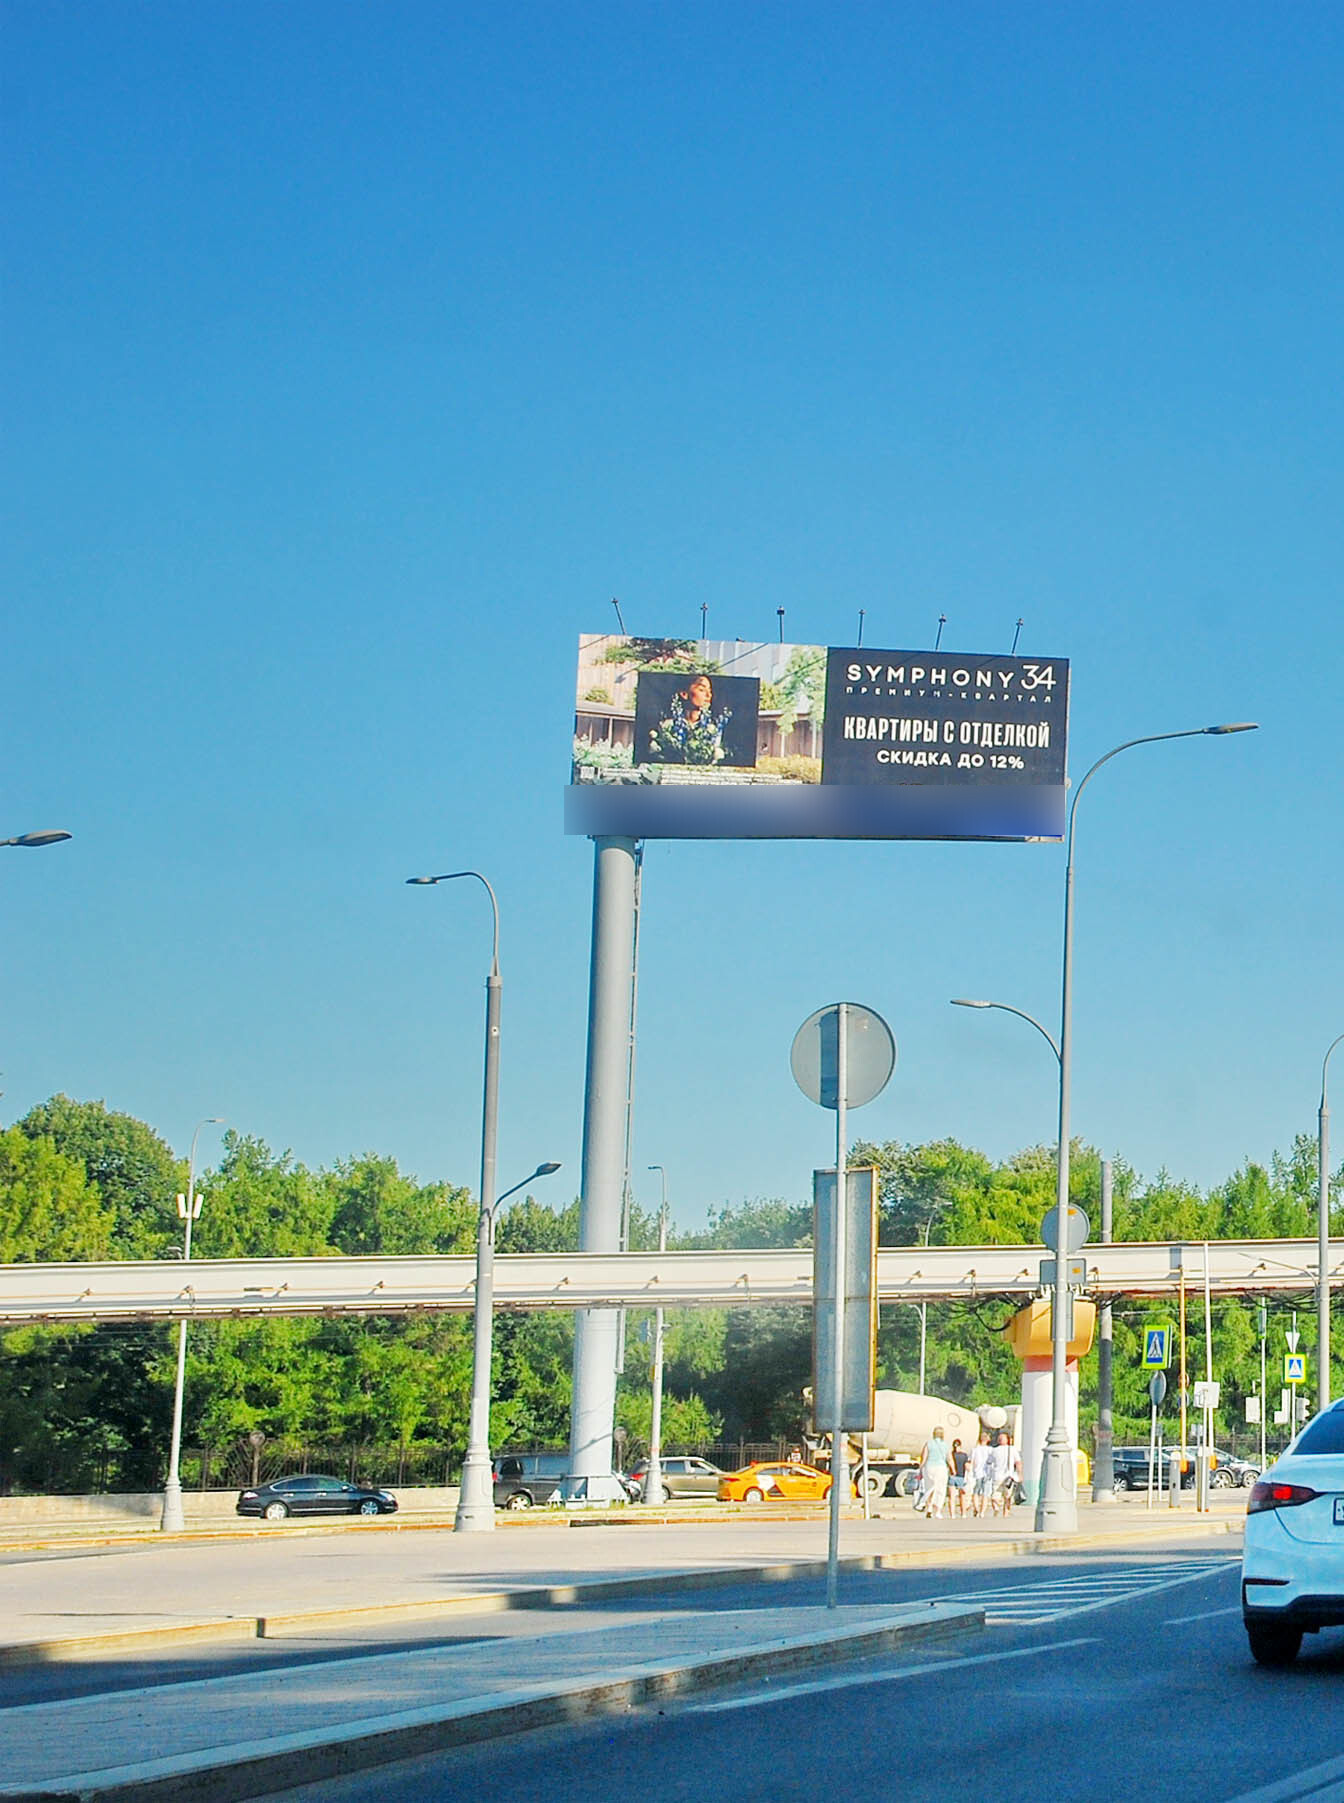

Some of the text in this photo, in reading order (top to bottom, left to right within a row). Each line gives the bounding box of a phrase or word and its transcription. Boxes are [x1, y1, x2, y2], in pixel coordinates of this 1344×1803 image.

[847, 664, 1057, 690] SYMPHONY 34
[844, 716, 1050, 748] КВАРТИРЫ С ОТДЕЛКОЙ
[876, 749, 1025, 770] СКИДКА ДО 12%
